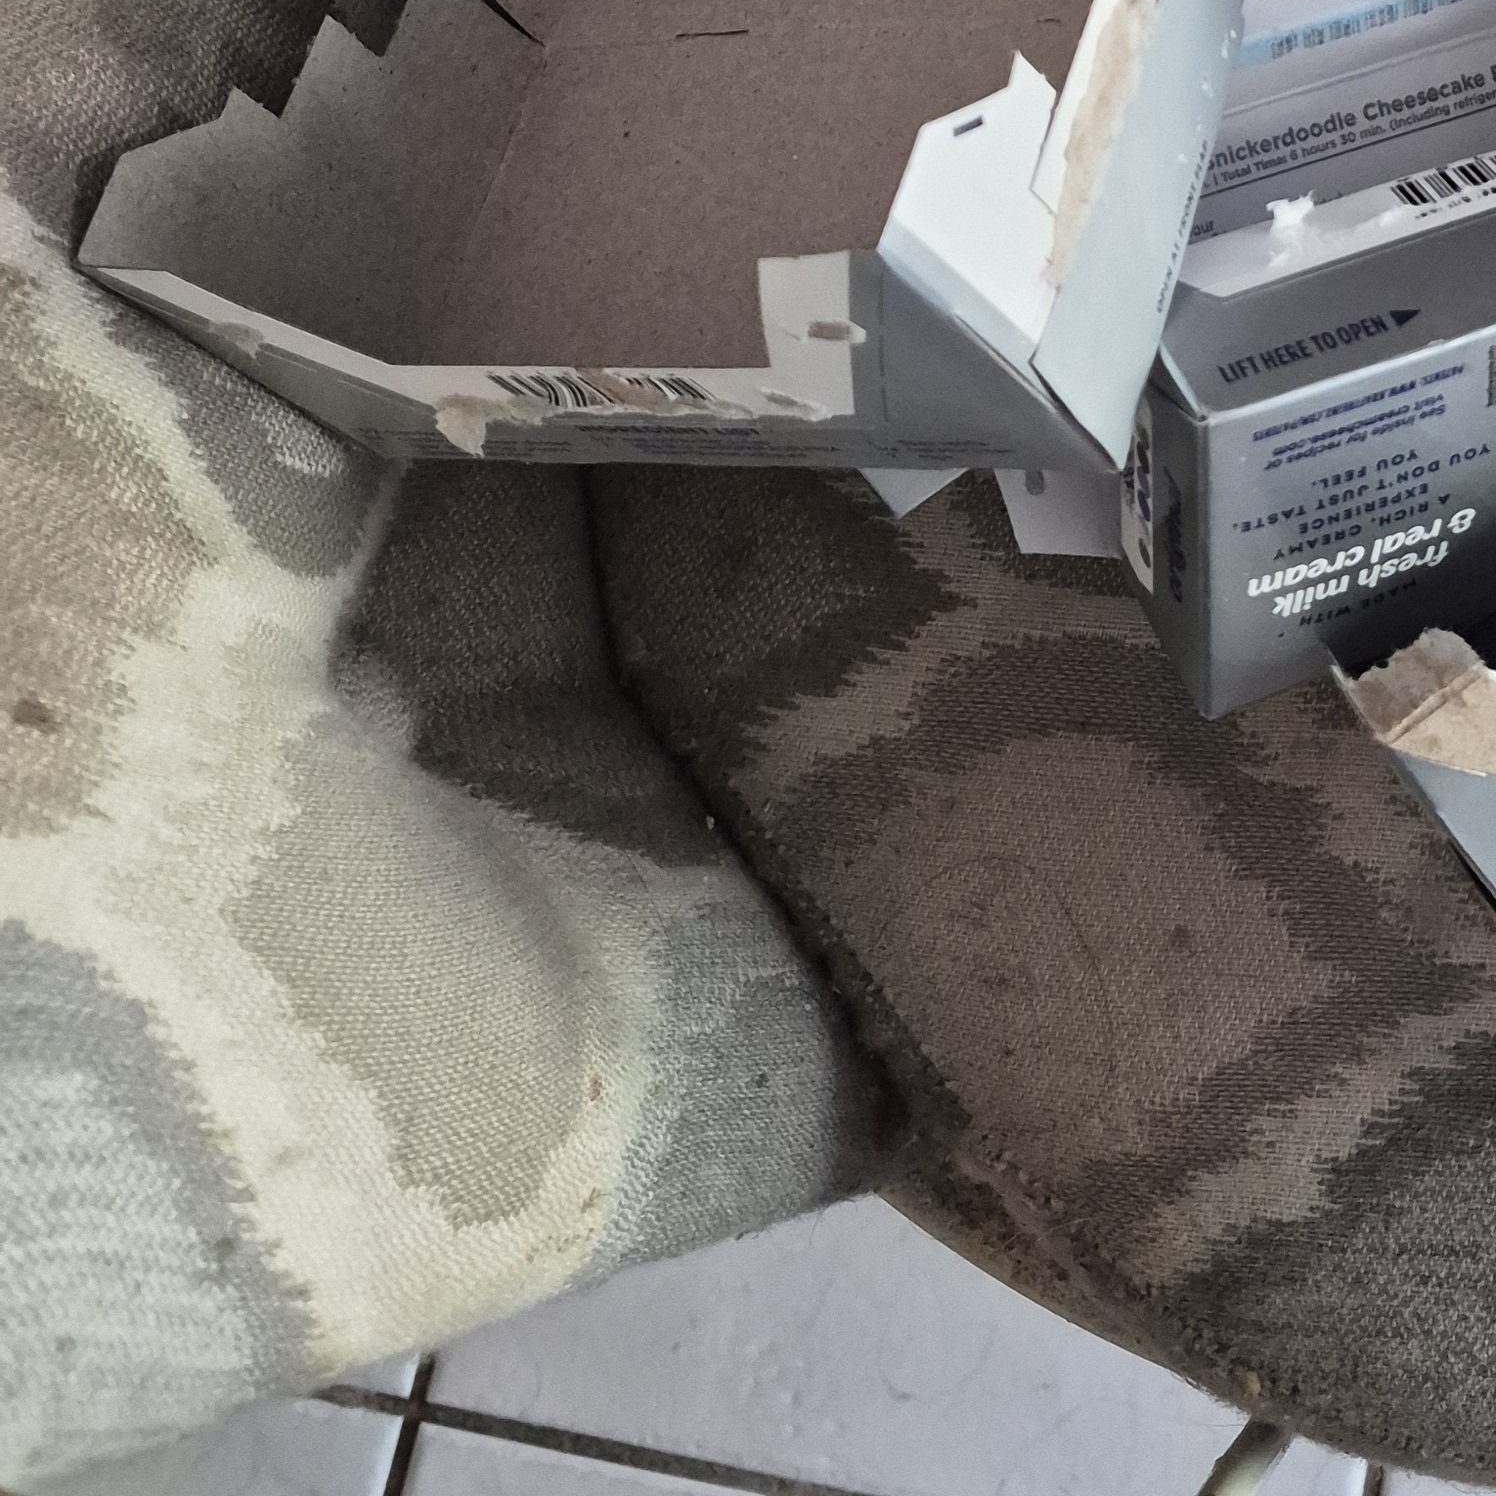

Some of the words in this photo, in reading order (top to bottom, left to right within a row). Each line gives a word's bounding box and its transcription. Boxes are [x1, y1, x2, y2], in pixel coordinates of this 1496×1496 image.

[1361, 72, 1485, 121] Cheesecake
[1217, 355, 1260, 382] LIFT
[1259, 338, 1312, 370] HERE
[1309, 330, 1338, 352] TO
[1335, 314, 1388, 344] OPEN
[1375, 448, 1418, 472] YOU
[1375, 459, 1440, 491] DON'T
[1448, 442, 1490, 466] YOU
[1298, 482, 1428, 535] EXPERIENCE
[1315, 484, 1369, 510] JUST
[1272, 523, 1362, 561] CREAMY
[1370, 517, 1442, 563] real
[1446, 507, 1476, 534] &
[1247, 545, 1365, 597] cream
[1356, 540, 1448, 588] fresh
[1271, 574, 1349, 617] milk
